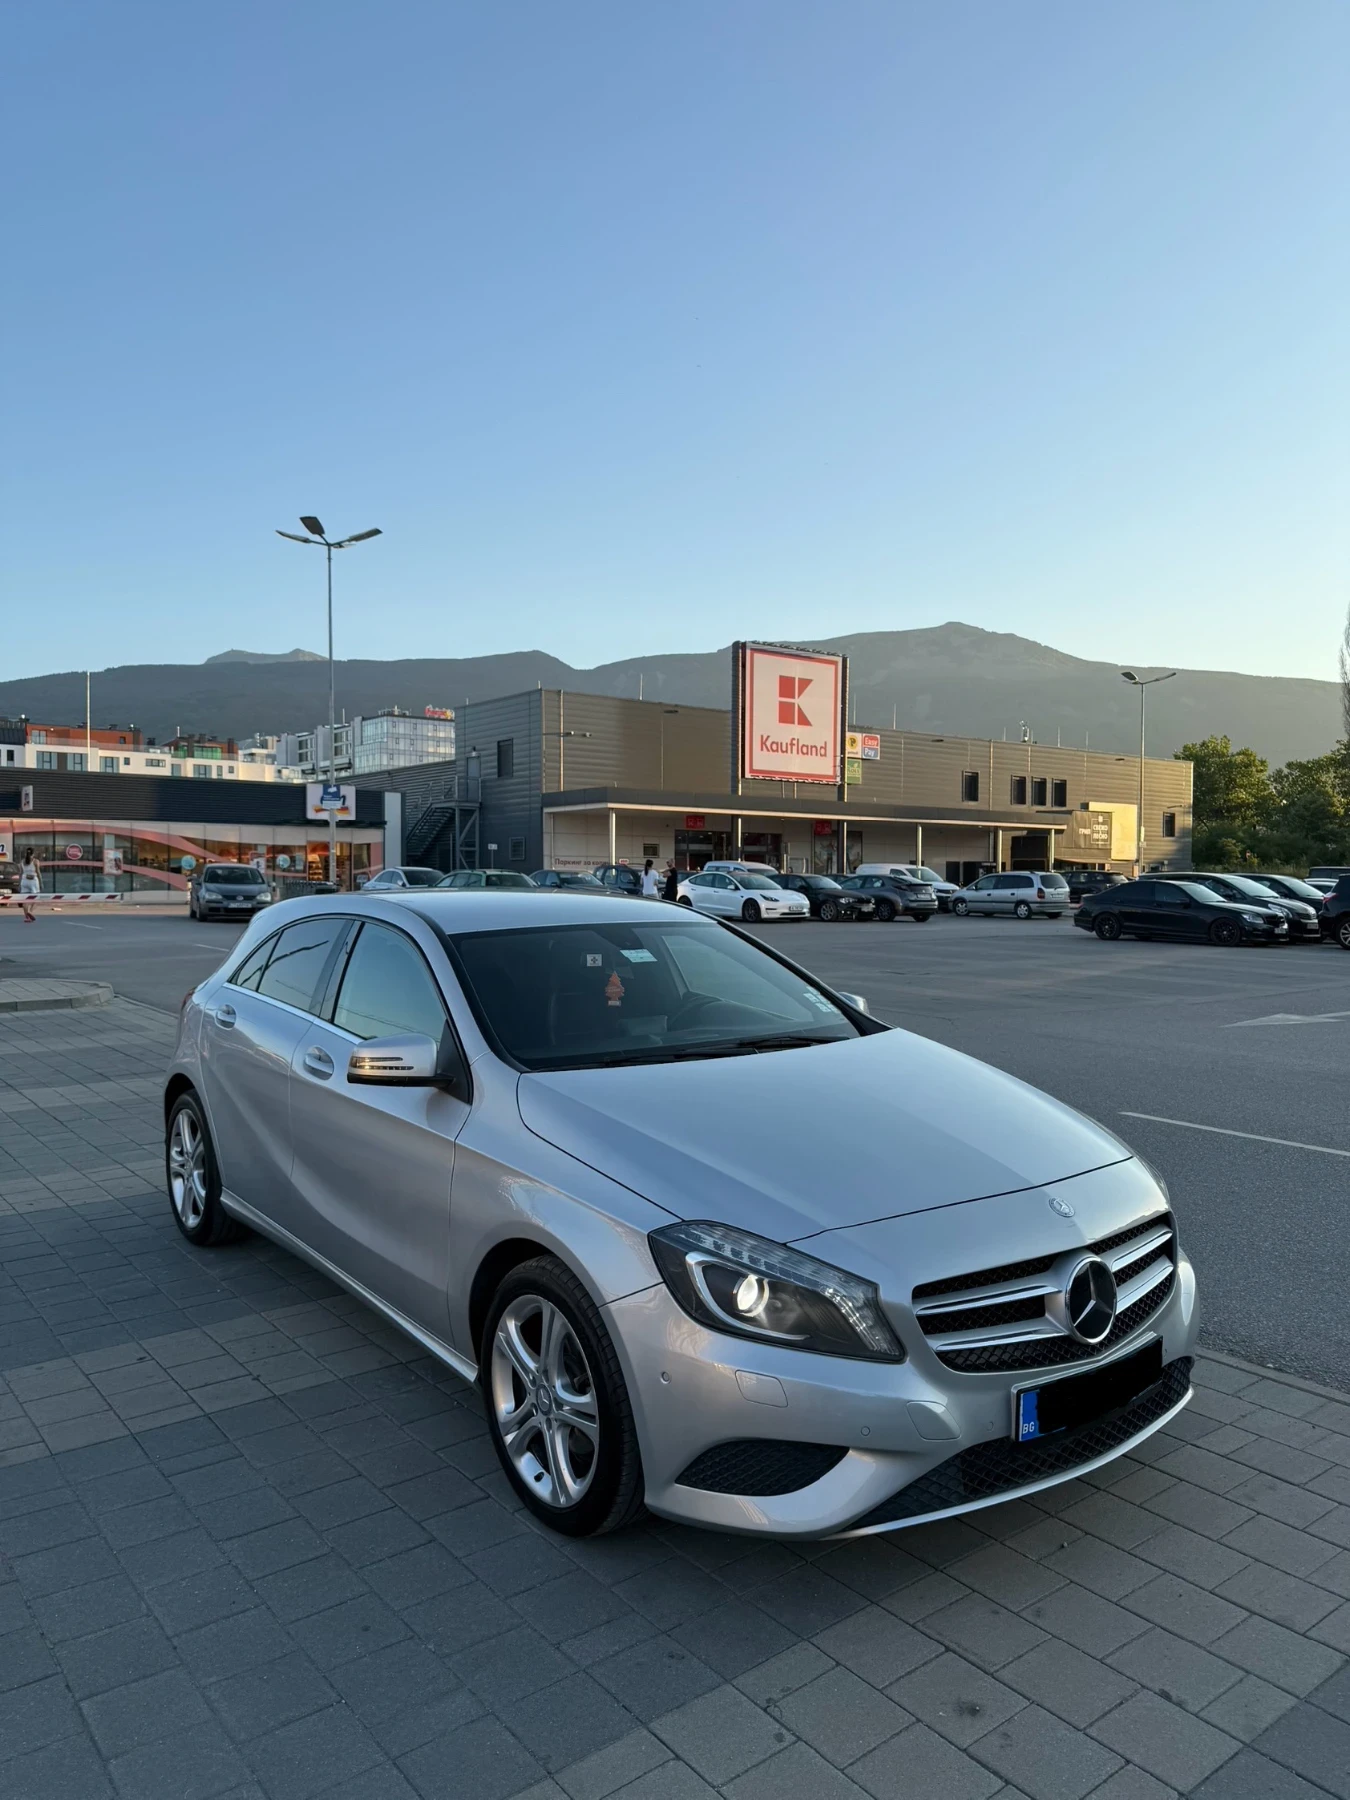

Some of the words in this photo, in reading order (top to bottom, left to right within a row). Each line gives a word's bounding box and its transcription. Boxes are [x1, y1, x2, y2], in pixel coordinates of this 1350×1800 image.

[760, 734, 827, 757] Kaufland
[864, 736, 879, 746] Easy
[864, 747, 876, 757] Pay
[1023, 1422, 1034, 1434] BG
